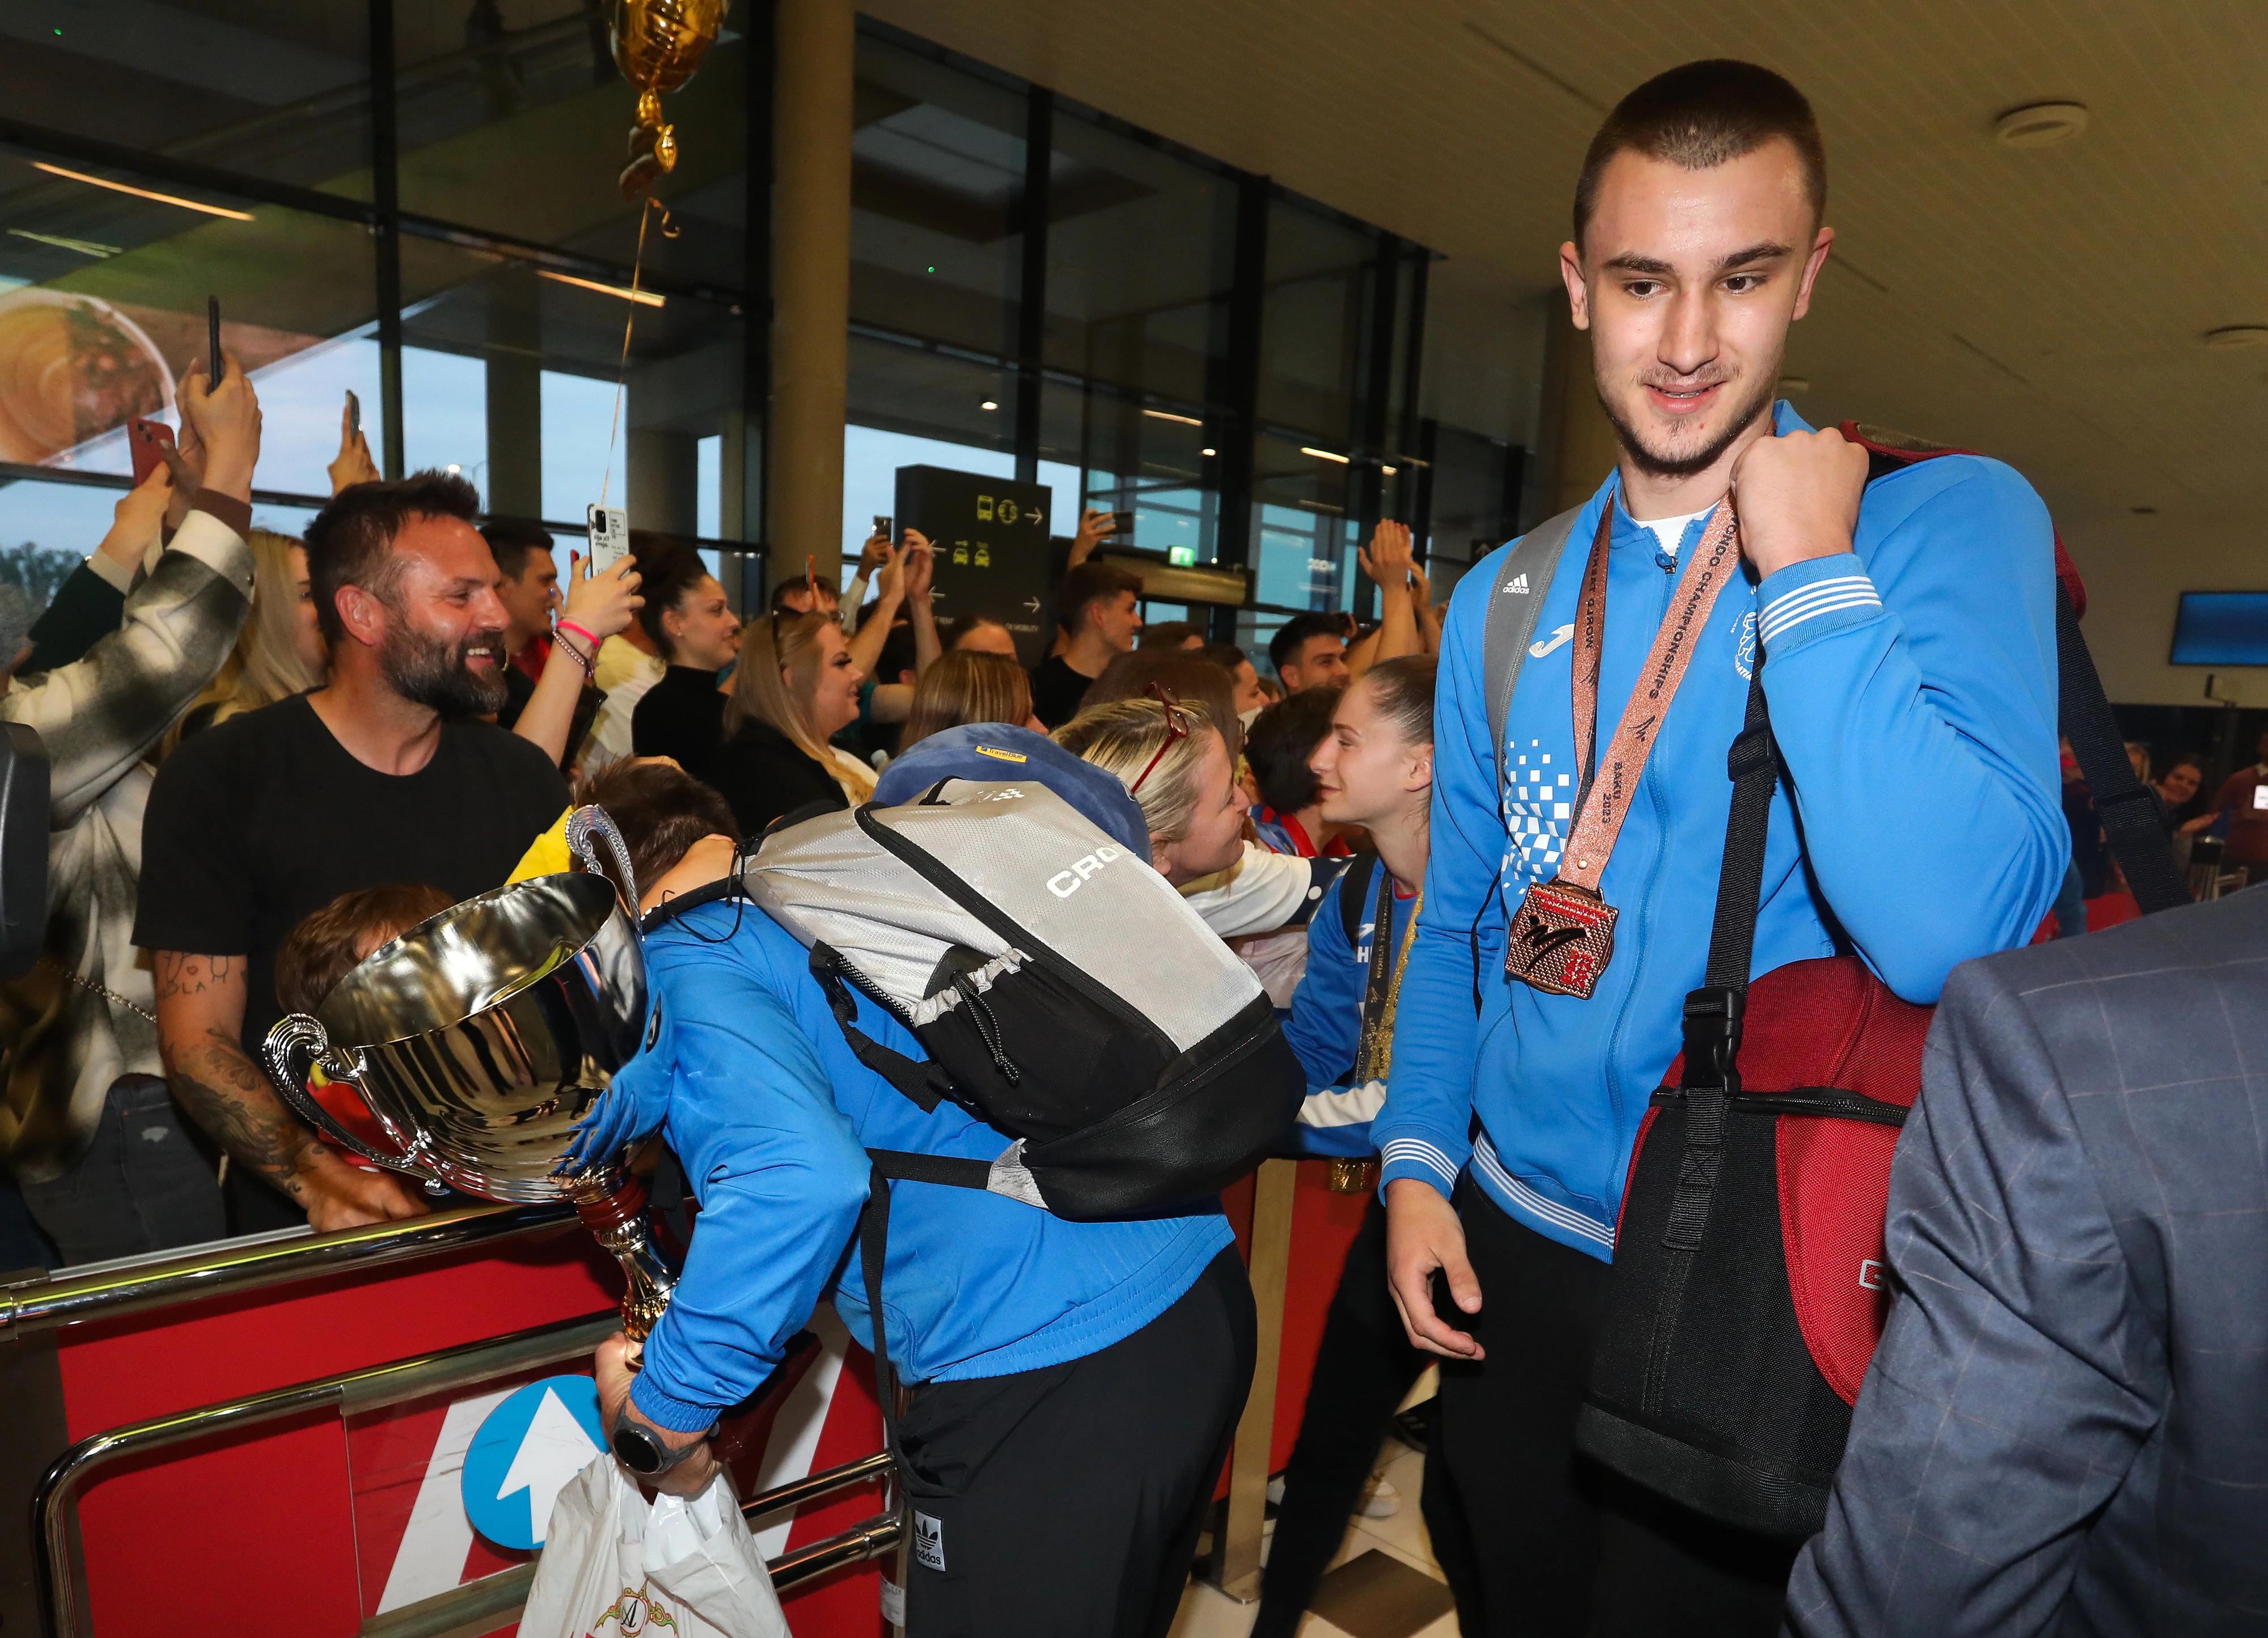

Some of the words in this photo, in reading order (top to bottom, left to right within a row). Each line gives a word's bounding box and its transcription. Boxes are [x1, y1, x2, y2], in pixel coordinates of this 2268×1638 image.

[1503, 586, 1530, 594] adidas
[1649, 571, 1712, 699] CHAMPIONSHIPS
[1613, 761, 1623, 799] BAKU
[1046, 846, 1120, 898] CRO
[916, 1548, 941, 1565] adidas
